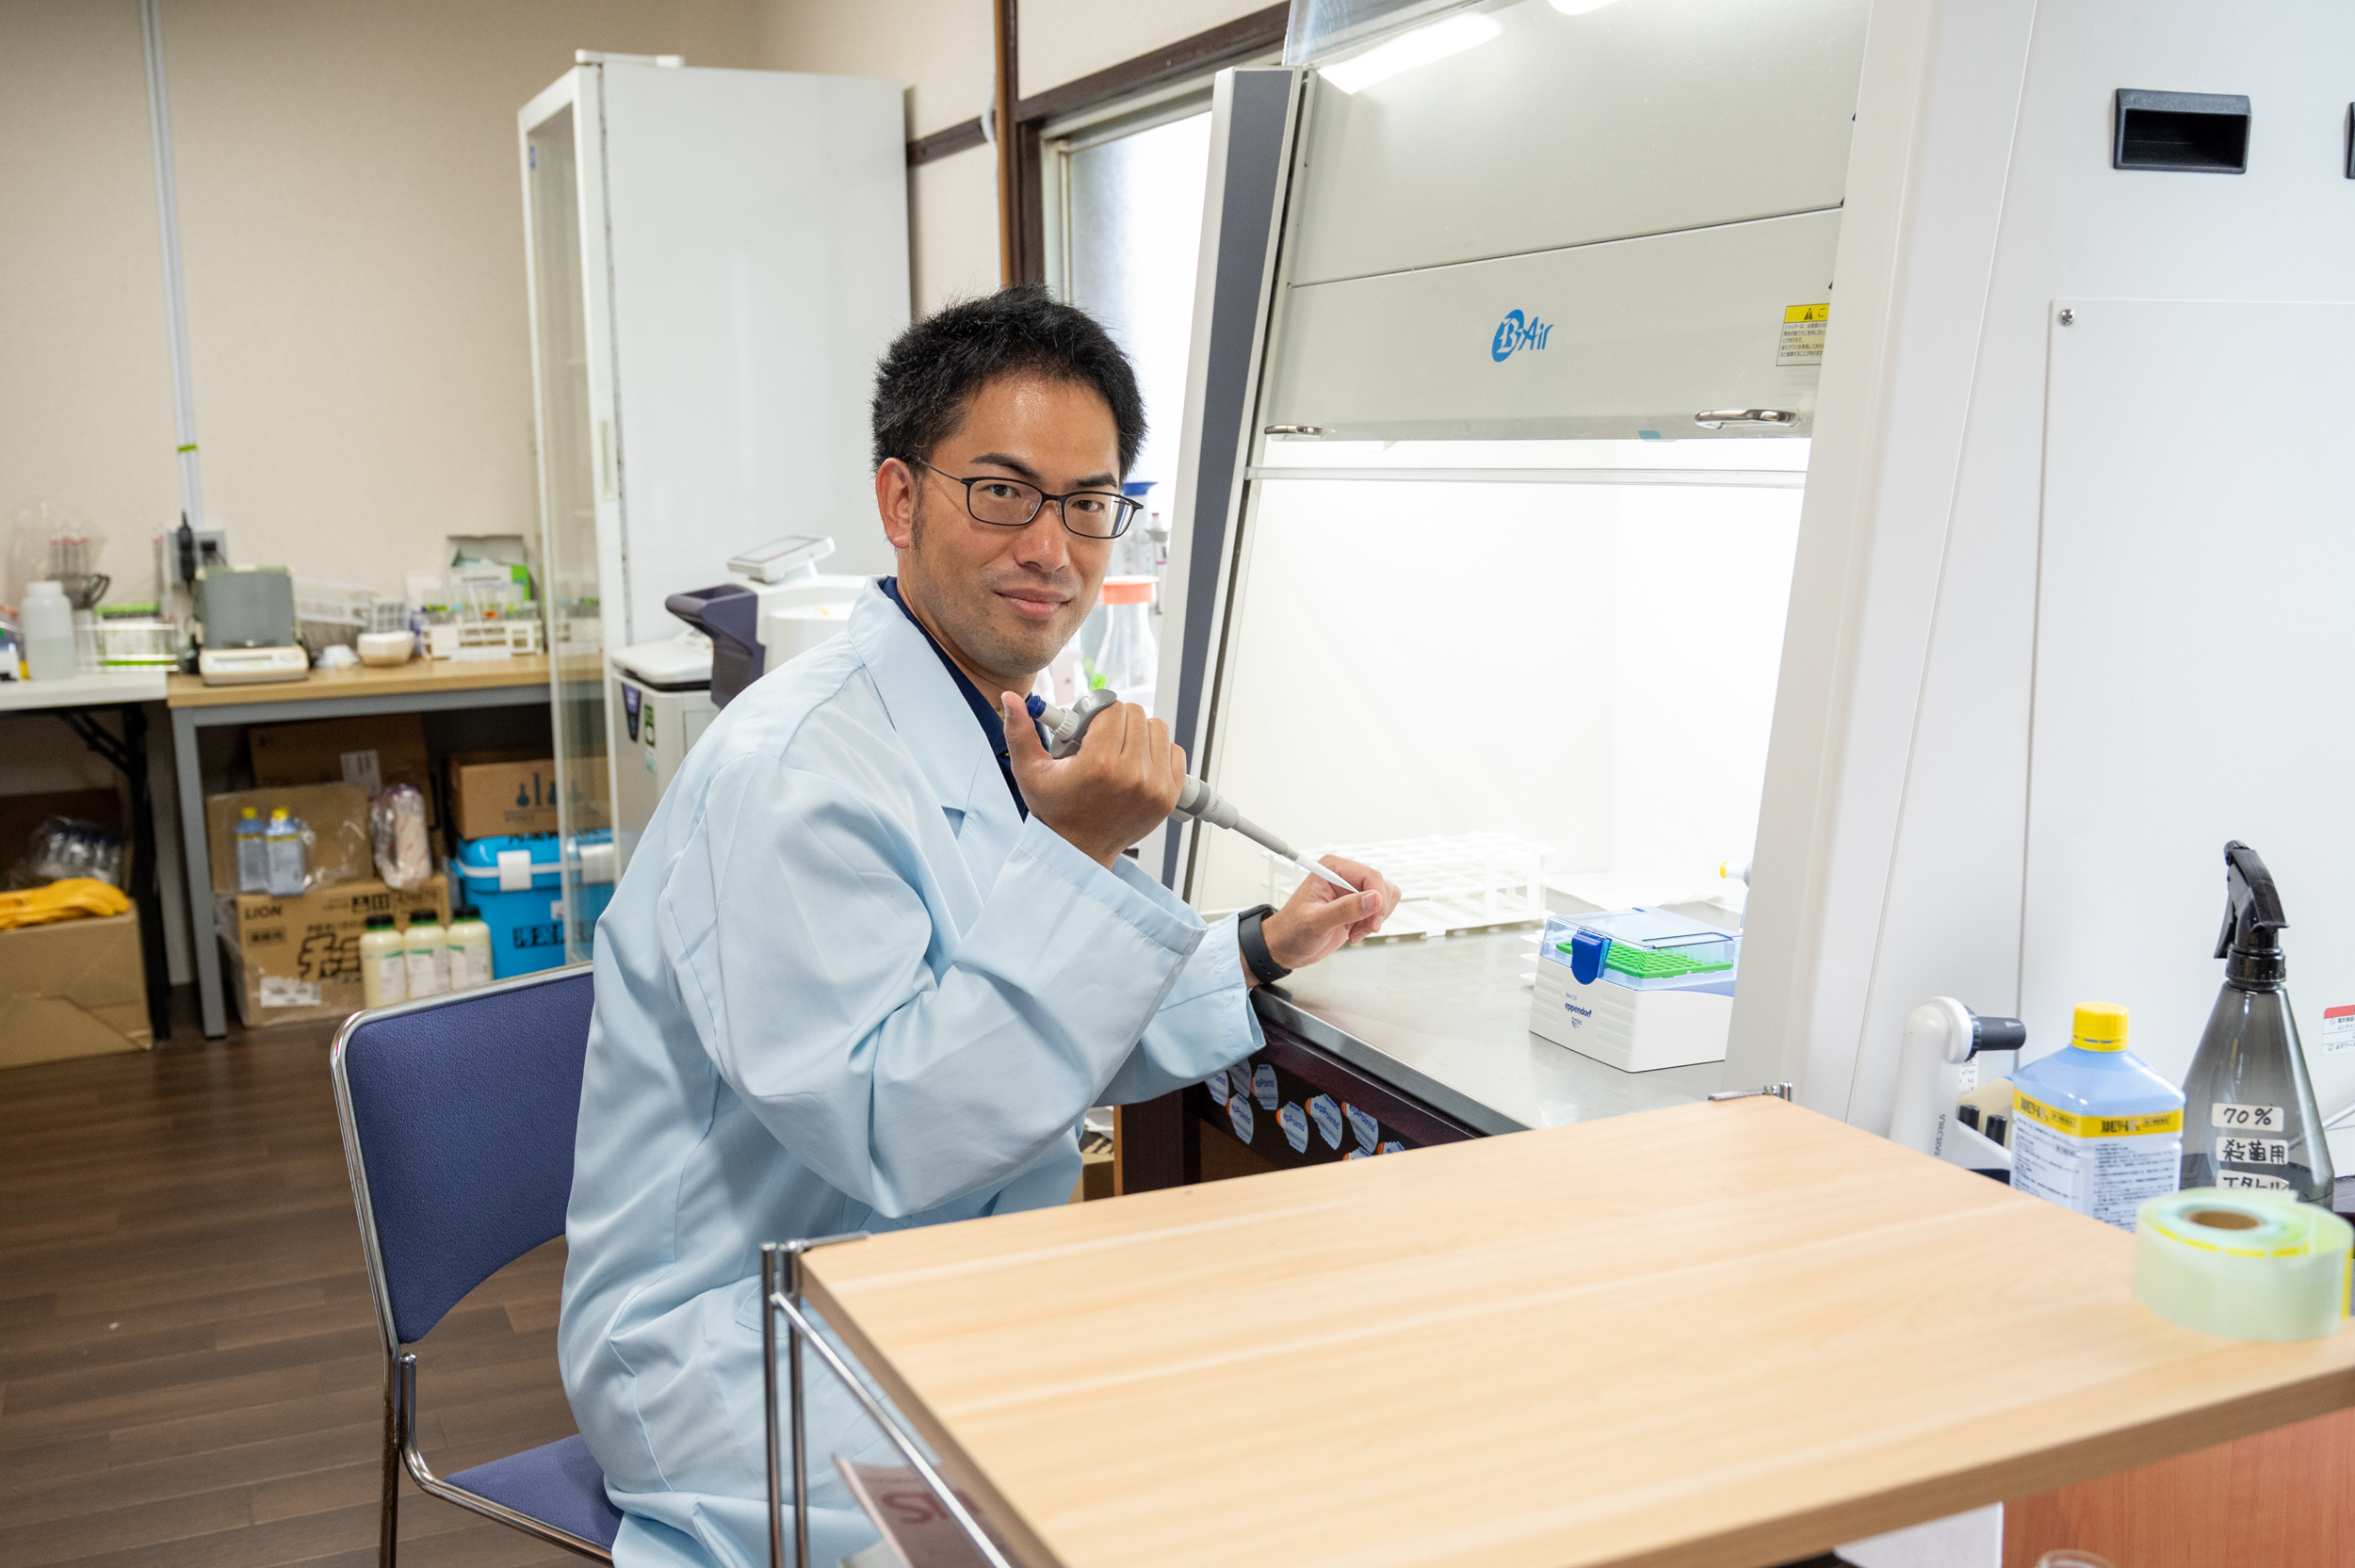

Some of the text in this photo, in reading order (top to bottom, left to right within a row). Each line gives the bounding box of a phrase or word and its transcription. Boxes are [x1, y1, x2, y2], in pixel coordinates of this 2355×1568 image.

[1211, 799, 1220, 813] 1000
[245, 905, 283, 920] LION
[1565, 1002, 1592, 1018] eppendorf
[2222, 1139, 2285, 1164] 殺菌用
